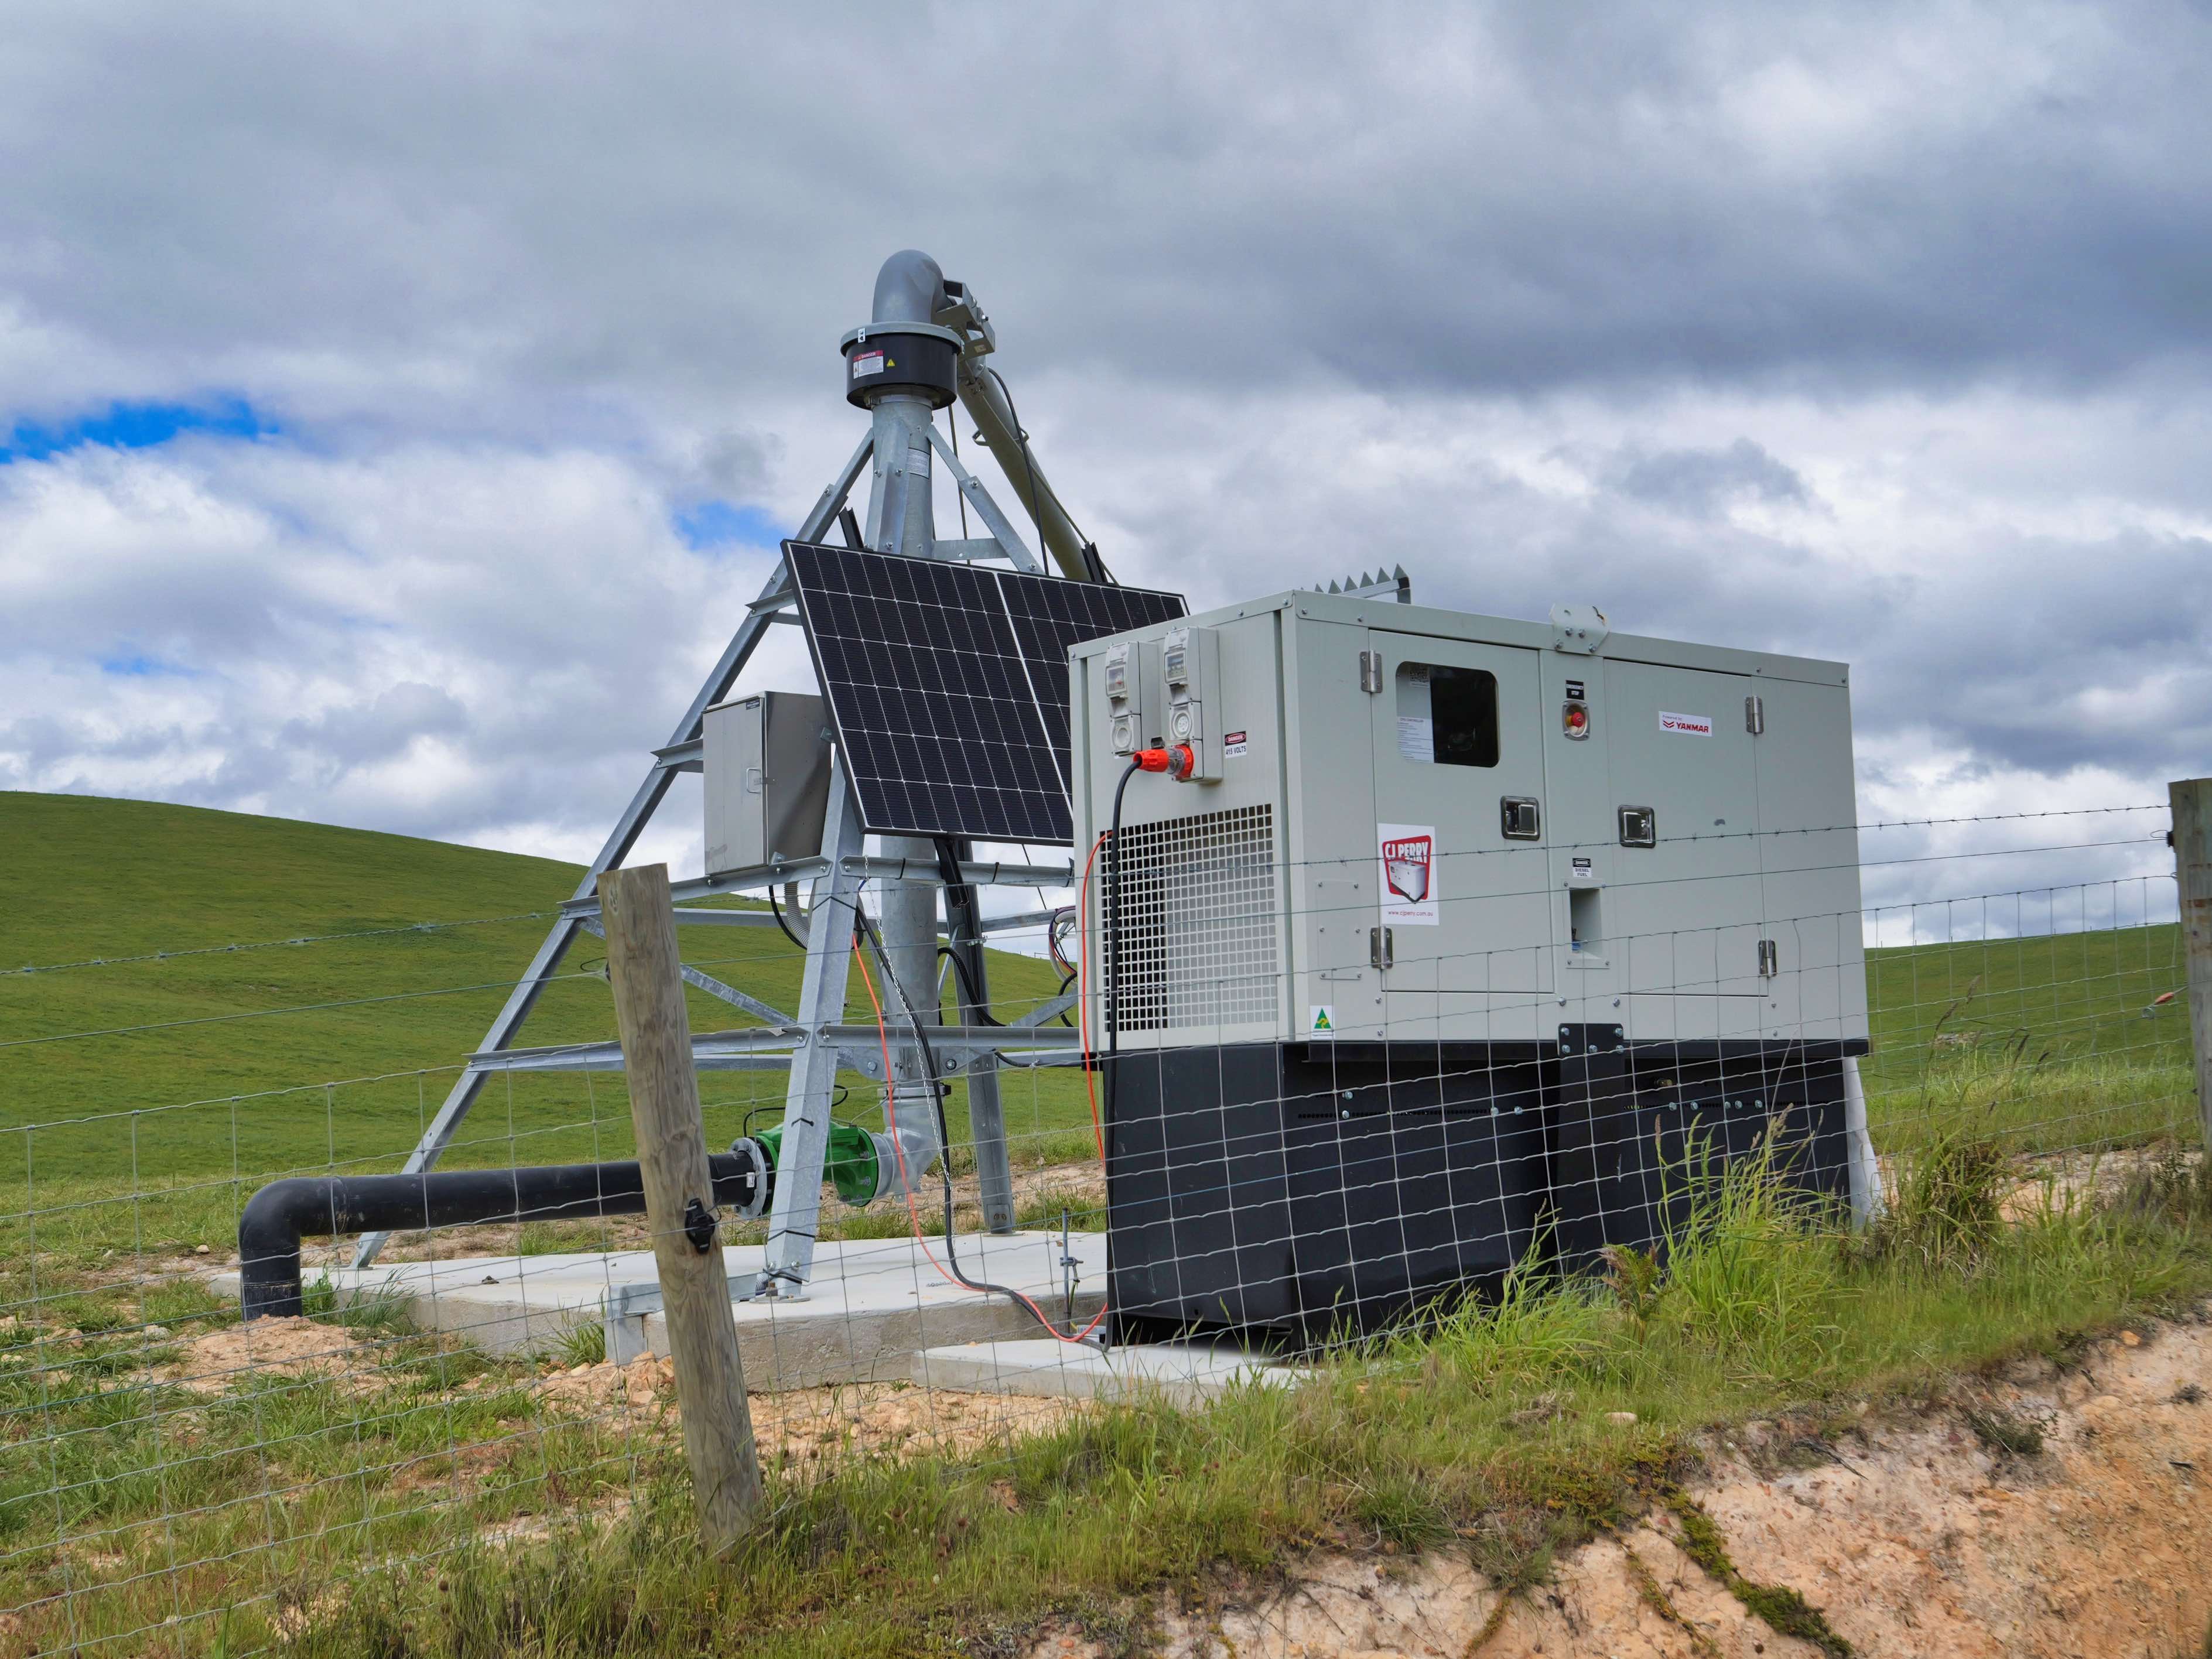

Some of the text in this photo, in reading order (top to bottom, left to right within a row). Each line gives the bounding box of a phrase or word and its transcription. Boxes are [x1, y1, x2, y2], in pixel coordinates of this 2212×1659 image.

[1676, 722, 1709, 733] YANMAR
[1234, 745, 1246, 754] VOLTS
[1385, 842, 1428, 863] CJ PERRY
